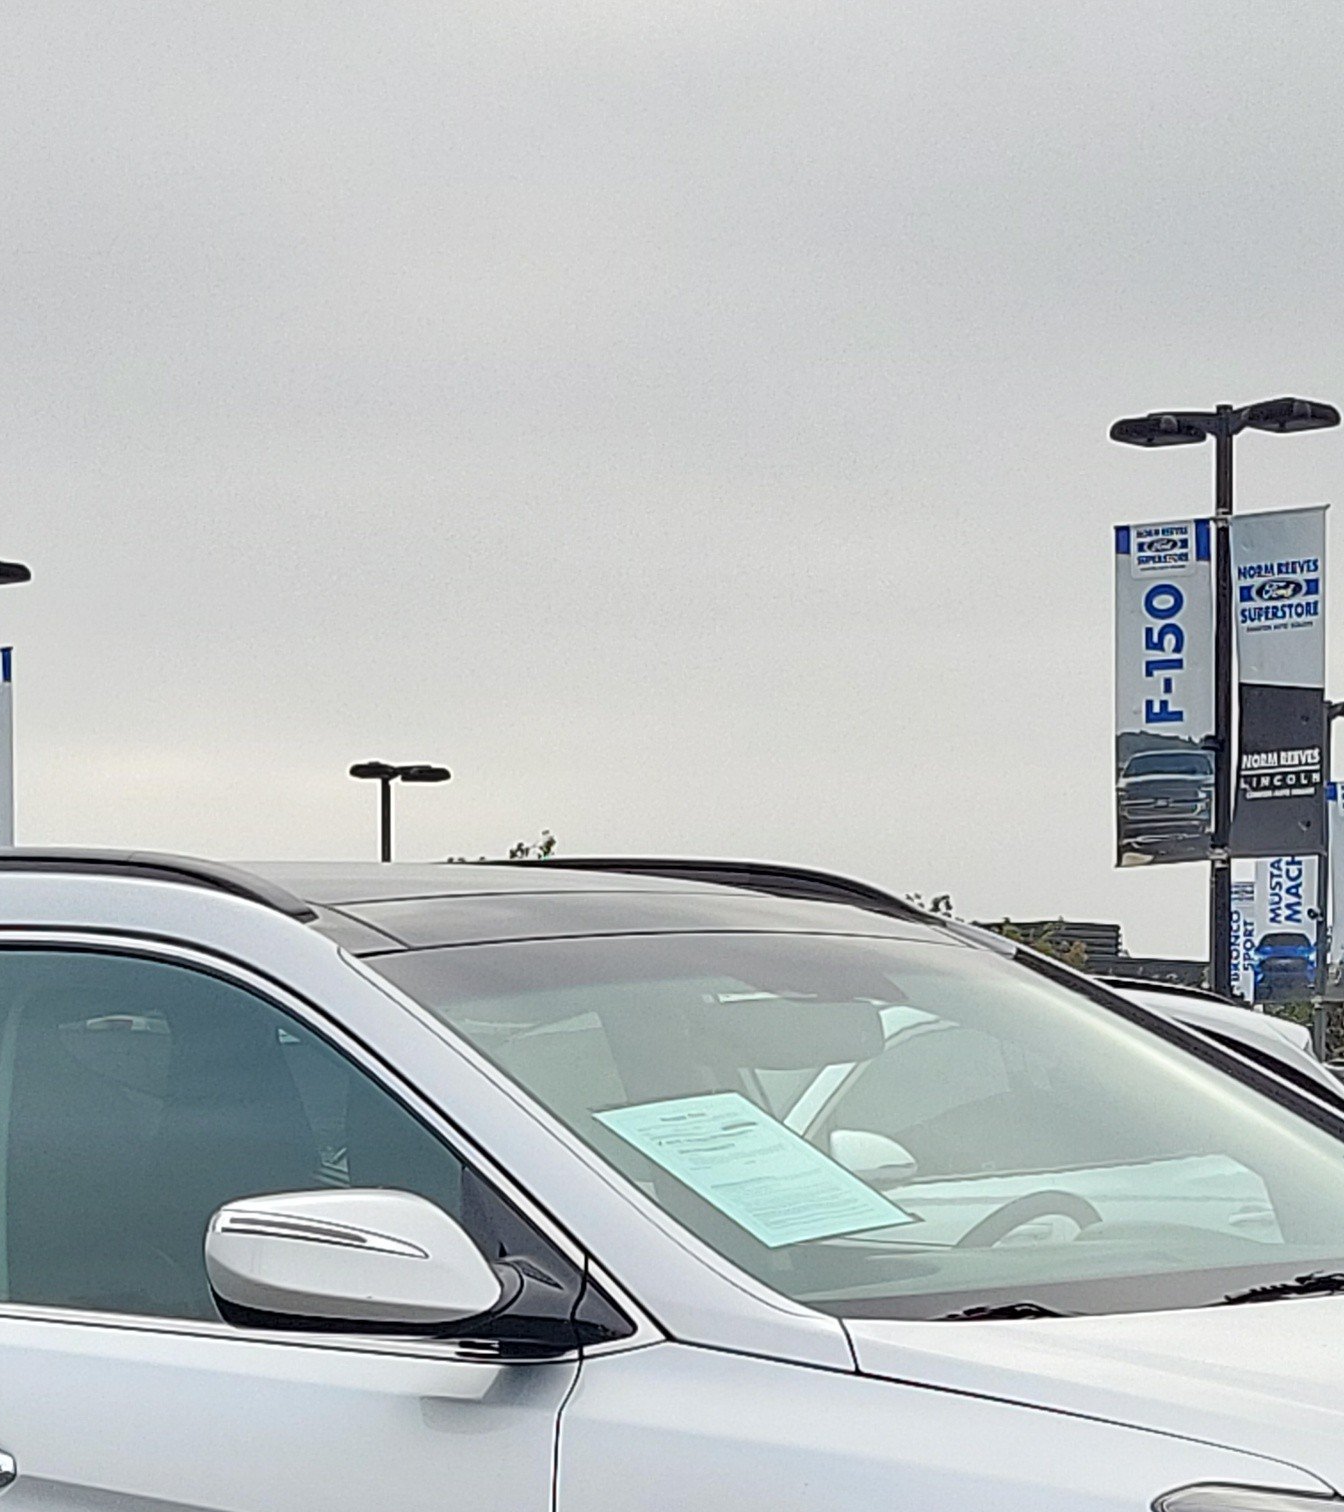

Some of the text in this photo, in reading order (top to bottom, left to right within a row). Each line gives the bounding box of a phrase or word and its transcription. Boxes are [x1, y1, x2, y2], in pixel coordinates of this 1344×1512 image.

[1237, 558, 1319, 580] NORM REEVES
[1240, 600, 1319, 624] SUPERSTORE
[1144, 583, 1184, 723] F-150
[1241, 747, 1320, 769] NORM REEVES
[1240, 772, 1321, 789] LINCOLN
[1269, 857, 1283, 924] MUSTA
[1284, 854, 1303, 923] MACH
[1243, 918, 1255, 971] SPORT
